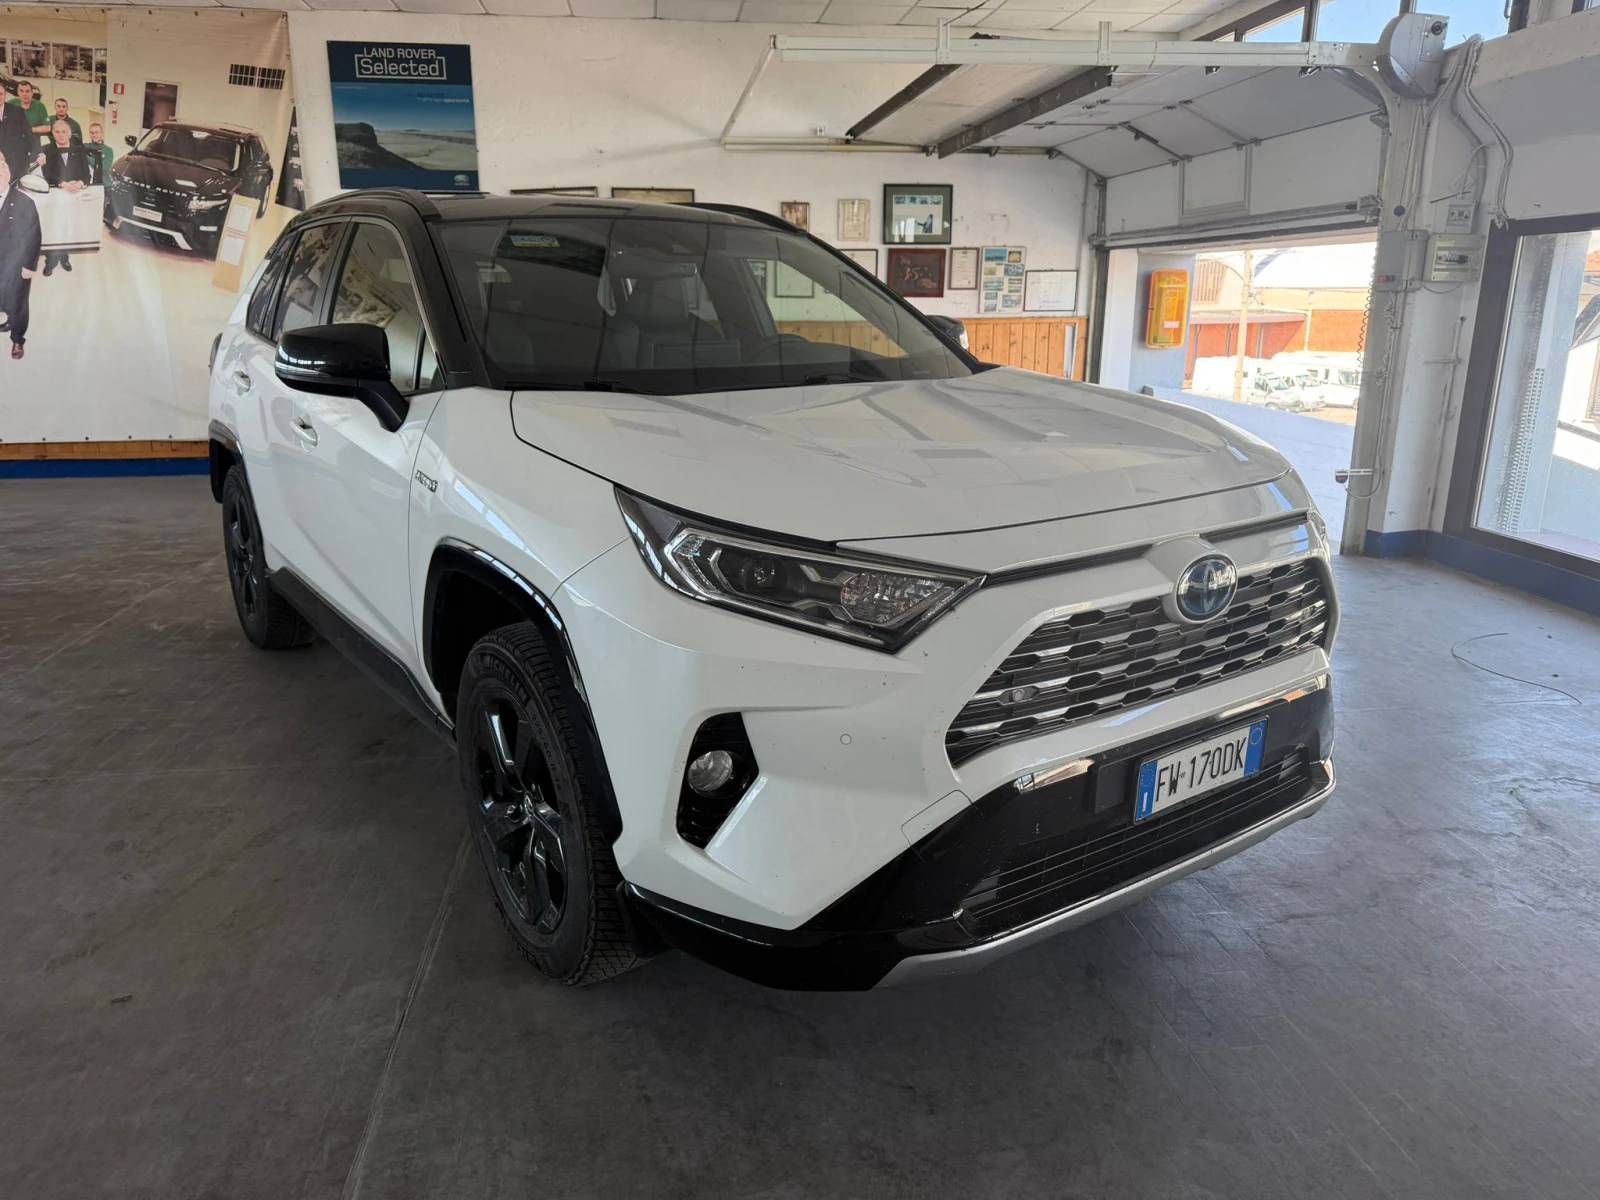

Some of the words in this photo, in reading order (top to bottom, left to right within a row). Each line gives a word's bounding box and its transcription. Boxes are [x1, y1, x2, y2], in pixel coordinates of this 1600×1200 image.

[363, 47, 395, 58] LAND
[397, 48, 436, 59] ROVER
[360, 58, 439, 76] Selected
[156, 187, 187, 197] ROVER
[483, 655, 529, 704] MICHELIN
[1156, 761, 1181, 802] FW
